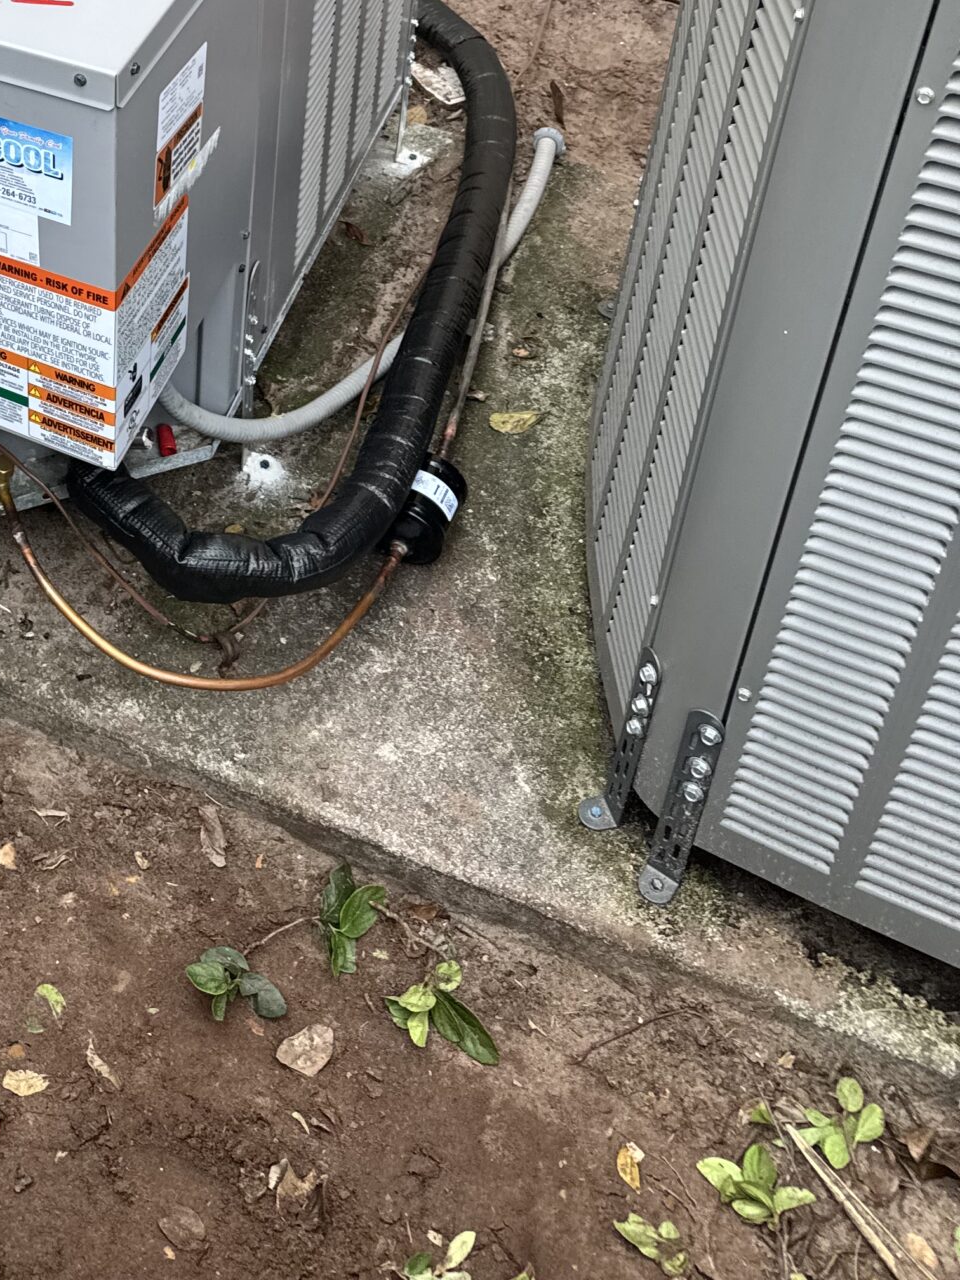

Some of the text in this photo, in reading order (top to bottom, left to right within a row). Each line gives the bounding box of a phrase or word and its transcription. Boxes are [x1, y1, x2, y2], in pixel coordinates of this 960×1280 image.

[0, 276, 37, 293] REFRIGERANT
[56, 295, 65, 303] TO
[65, 298, 72, 306] BE
[74, 301, 102, 316] REPAIRED
[13, 288, 35, 302] SERVICE
[74, 309, 83, 318] DO
[84, 313, 97, 322] NOT
[45, 277, 68, 292] RISK
[71, 286, 84, 296] OF
[86, 291, 109, 305] FIRE
[0, 301, 38, 320] ACCORDANCE
[40, 314, 55, 326] WITH
[56, 321, 81, 335] FEDERAL
[83, 329, 91, 338] OR
[93, 332, 112, 345] LOCAL
[56, 313, 81, 327] DISPOSE
[82, 321, 90, 329] OF
[1, 331, 30, 345] AUXILIARY
[31, 342, 54, 356] DEVICES
[55, 351, 74, 363] LISTED
[76, 358, 87, 367] FOR
[89, 363, 100, 372] USE
[12, 328, 41, 344] INSTALLED
[50, 341, 60, 350] THE
[18, 322, 37, 334] WHICH
[39, 329, 51, 340] MAY
[61, 337, 87, 352] IGNITION
[50, 357, 60, 366] SEE
[55, 371, 96, 392] WARNING
[46, 393, 105, 422] ADVERTENCIA
[41, 417, 115, 450] ADVERTISSEMENT
